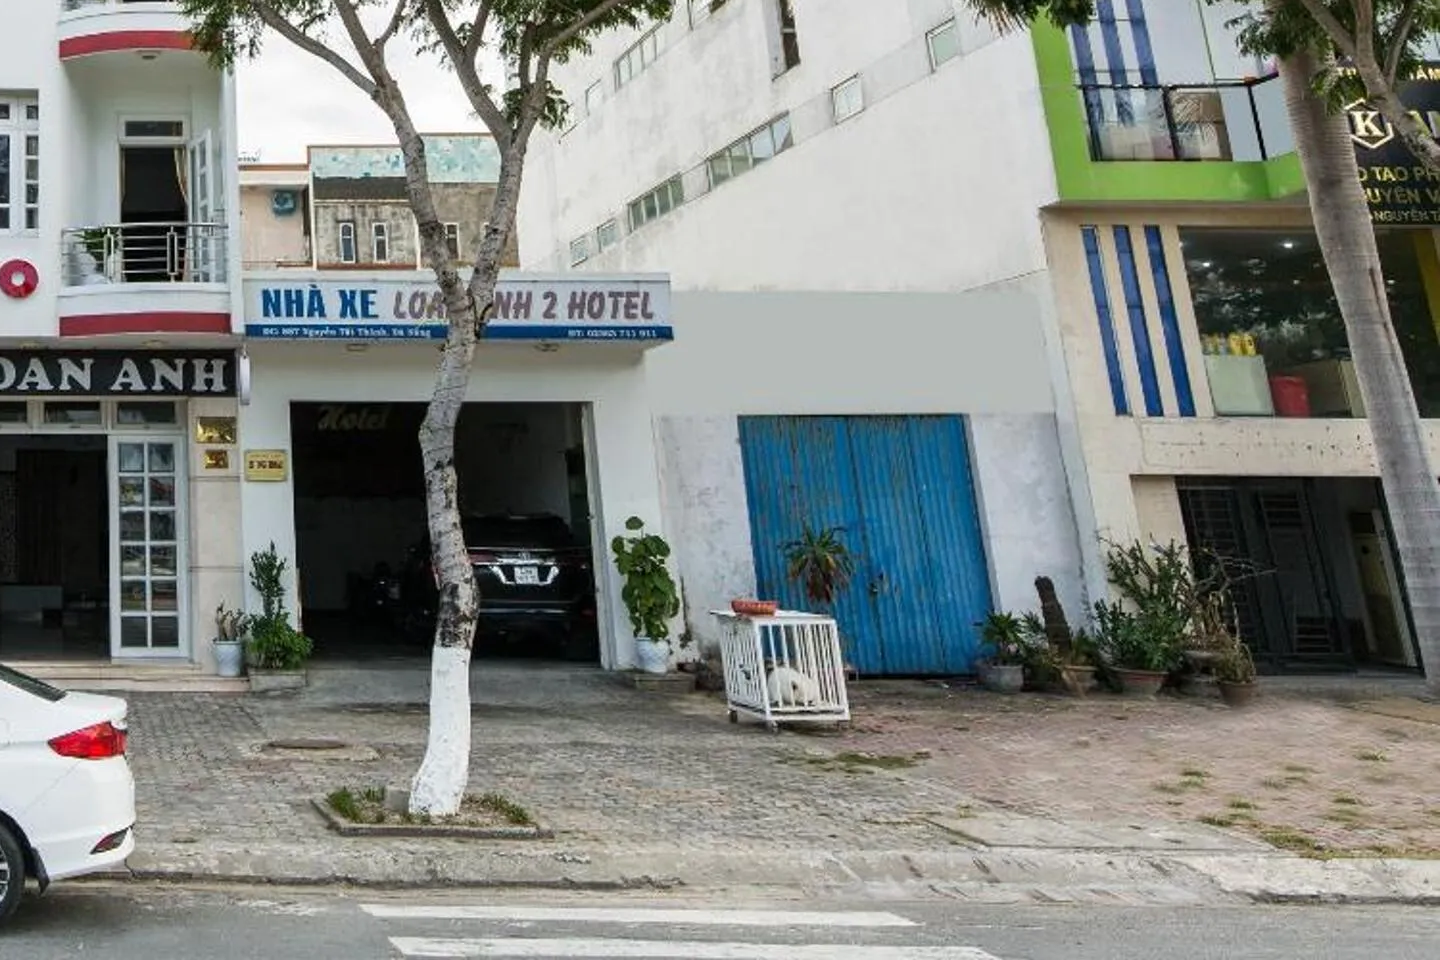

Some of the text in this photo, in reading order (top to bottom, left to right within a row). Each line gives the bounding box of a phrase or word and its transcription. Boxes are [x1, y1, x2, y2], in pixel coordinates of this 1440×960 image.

[1350, 110, 1385, 137] K
[262, 284, 655, 320] NHÀ XE LOA NH 2 HOTEL
[109, 358, 228, 392] ANH
